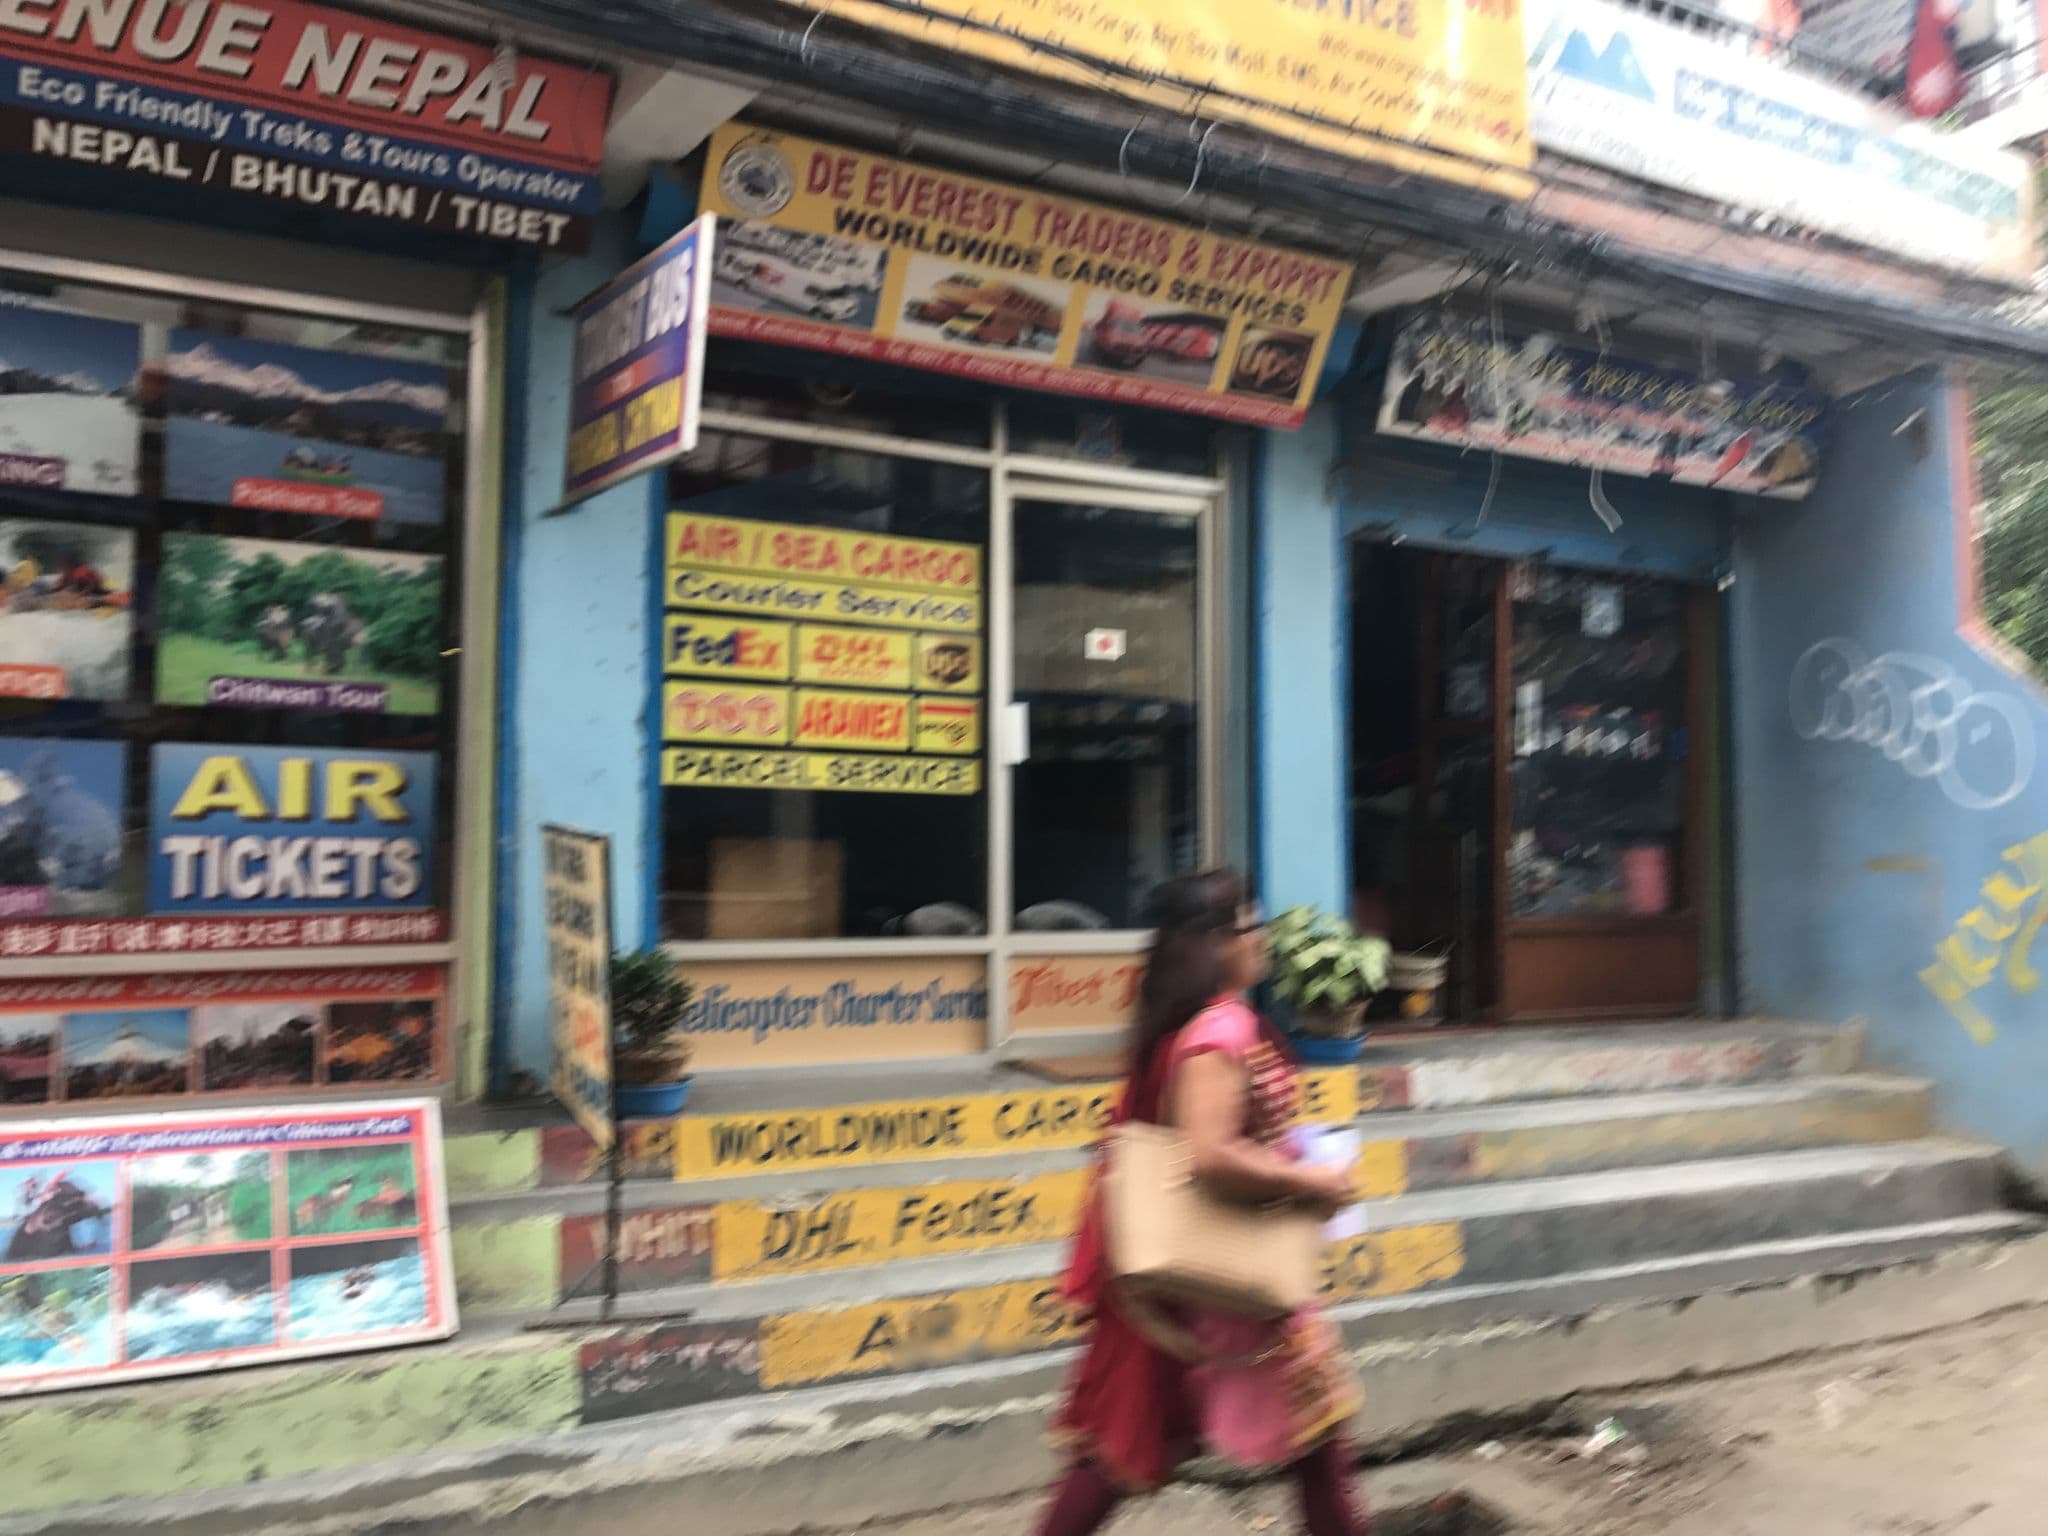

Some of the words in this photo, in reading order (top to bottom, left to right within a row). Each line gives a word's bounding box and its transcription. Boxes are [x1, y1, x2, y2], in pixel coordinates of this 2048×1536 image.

[282, 22, 552, 141] NEPAL
[17, 66, 85, 105] Eco
[94, 81, 233, 139] Friendly
[240, 108, 332, 156] Treks
[457, 153, 583, 202] Operator
[31, 117, 193, 179] NEPAL
[230, 155, 417, 221] BHUTAN
[451, 196, 570, 247] TIBET
[806, 151, 859, 200] DE
[864, 163, 1024, 237] EVEREST
[1031, 203, 1173, 269] TRADERS
[1178, 236, 1201, 274] &
[834, 206, 1042, 274] WORLDWIDE
[1052, 253, 1160, 297] CARGO
[1169, 277, 1308, 325] SERVICES
[676, 521, 741, 560] AIR
[772, 530, 840, 571] SEA
[853, 540, 976, 586] CARGO
[674, 571, 826, 610] Courier
[836, 588, 976, 625] Service
[669, 625, 781, 668] FedEx
[325, 684, 388, 710] Tour
[171, 754, 409, 822] AIR
[671, 752, 816, 785] PARCEL
[826, 759, 975, 792] SERVICE
[161, 834, 422, 900] TICKETS
[682, 984, 818, 1044] elicopter
[709, 1102, 965, 1167] WORLDWIDE
[993, 1092, 1112, 1140] CARG
